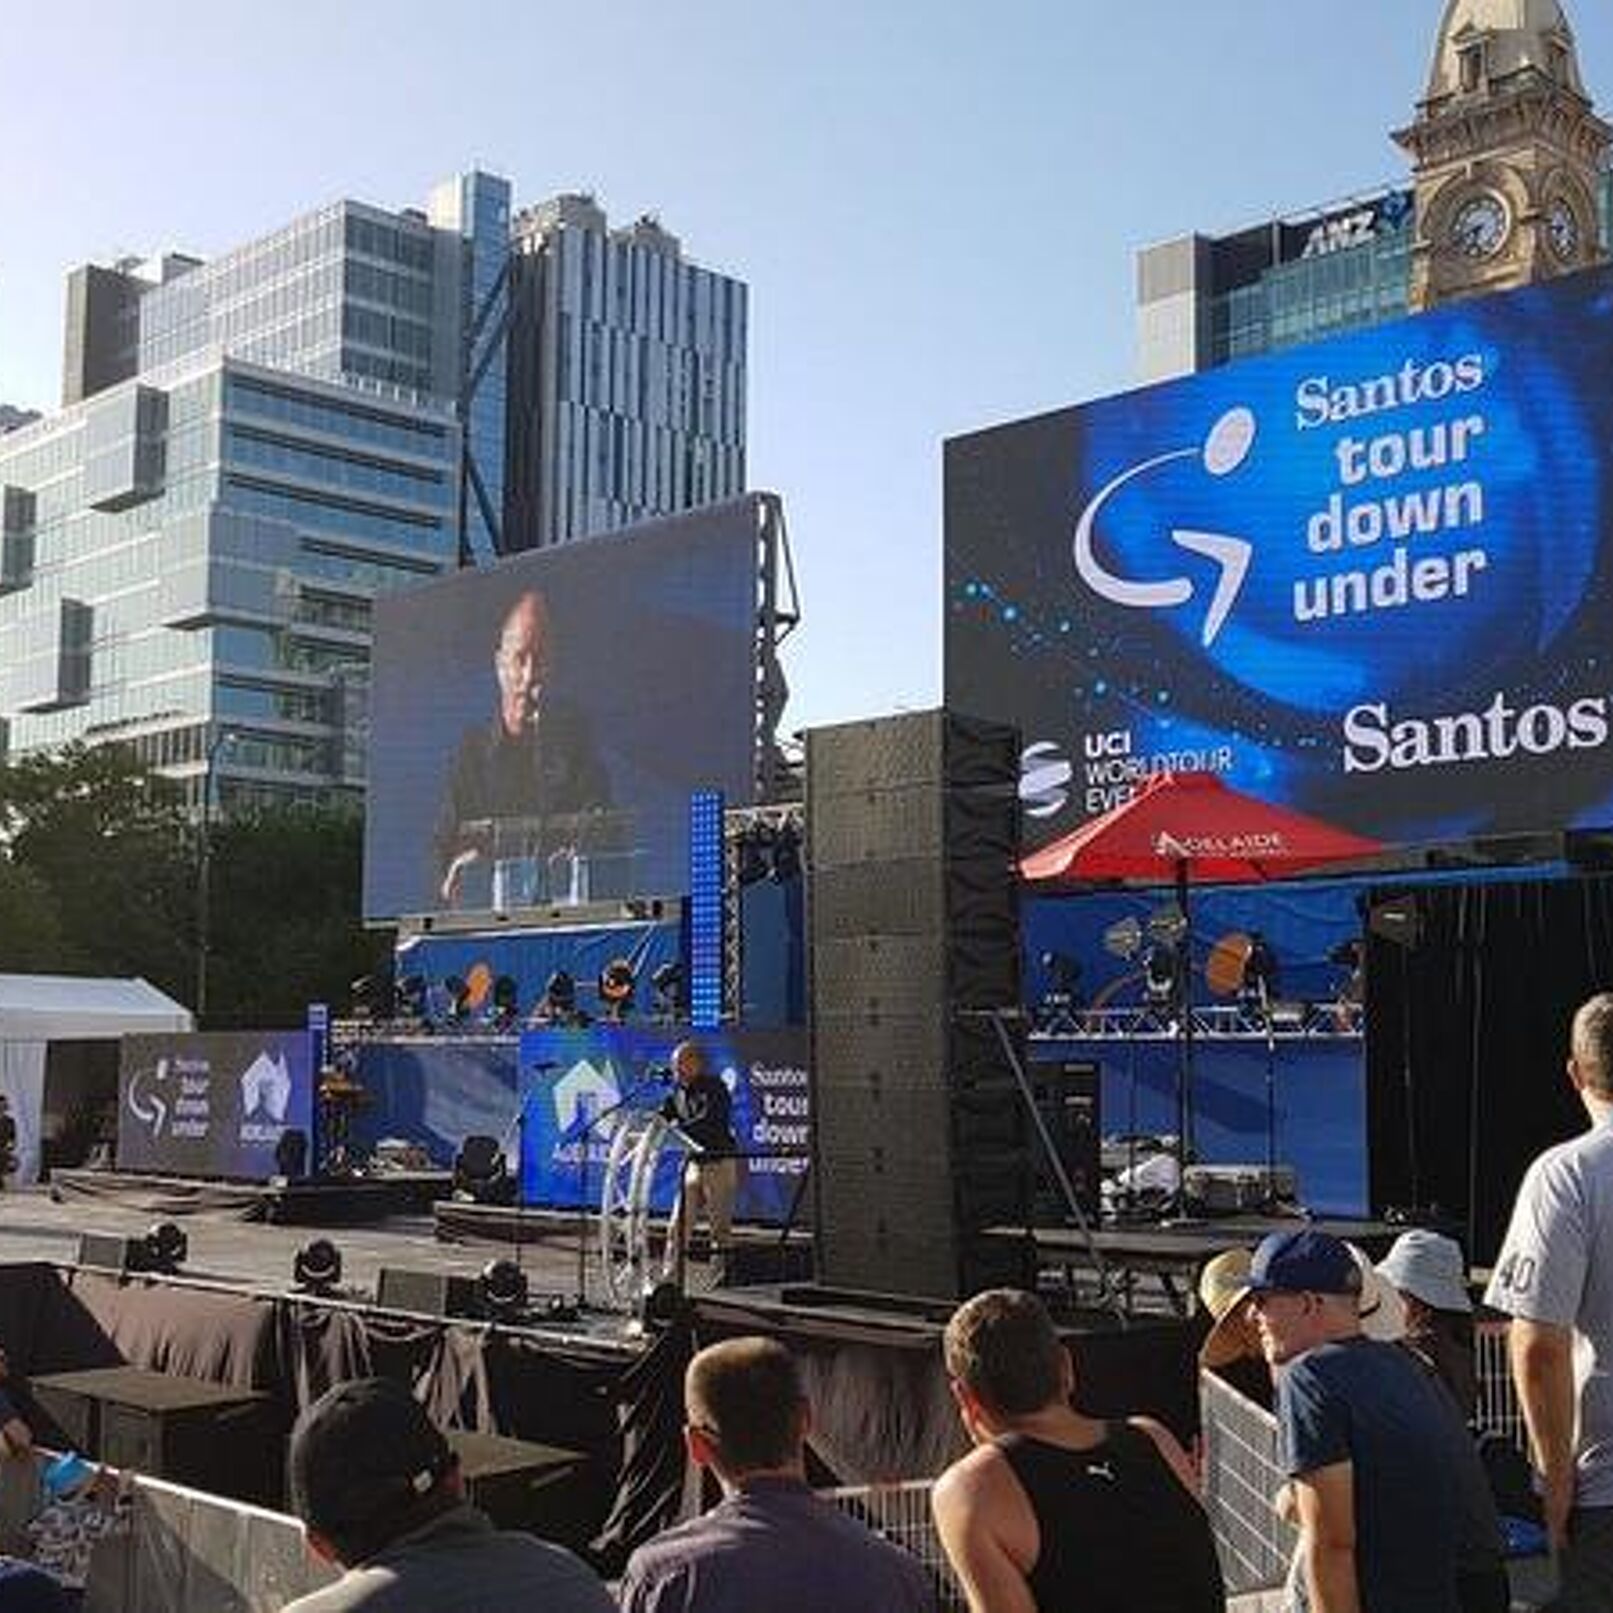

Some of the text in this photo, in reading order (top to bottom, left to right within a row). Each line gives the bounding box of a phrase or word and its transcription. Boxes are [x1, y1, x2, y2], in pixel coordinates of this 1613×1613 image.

[1301, 210, 1376, 259] ANZ
[1296, 353, 1484, 430] Santos
[1336, 414, 1485, 484] tour
[1308, 480, 1483, 553] down
[1293, 547, 1487, 621] under
[1085, 730, 1131, 758] UCI
[1344, 691, 1608, 772] Santos
[1500, 1252, 1535, 1294] 40
